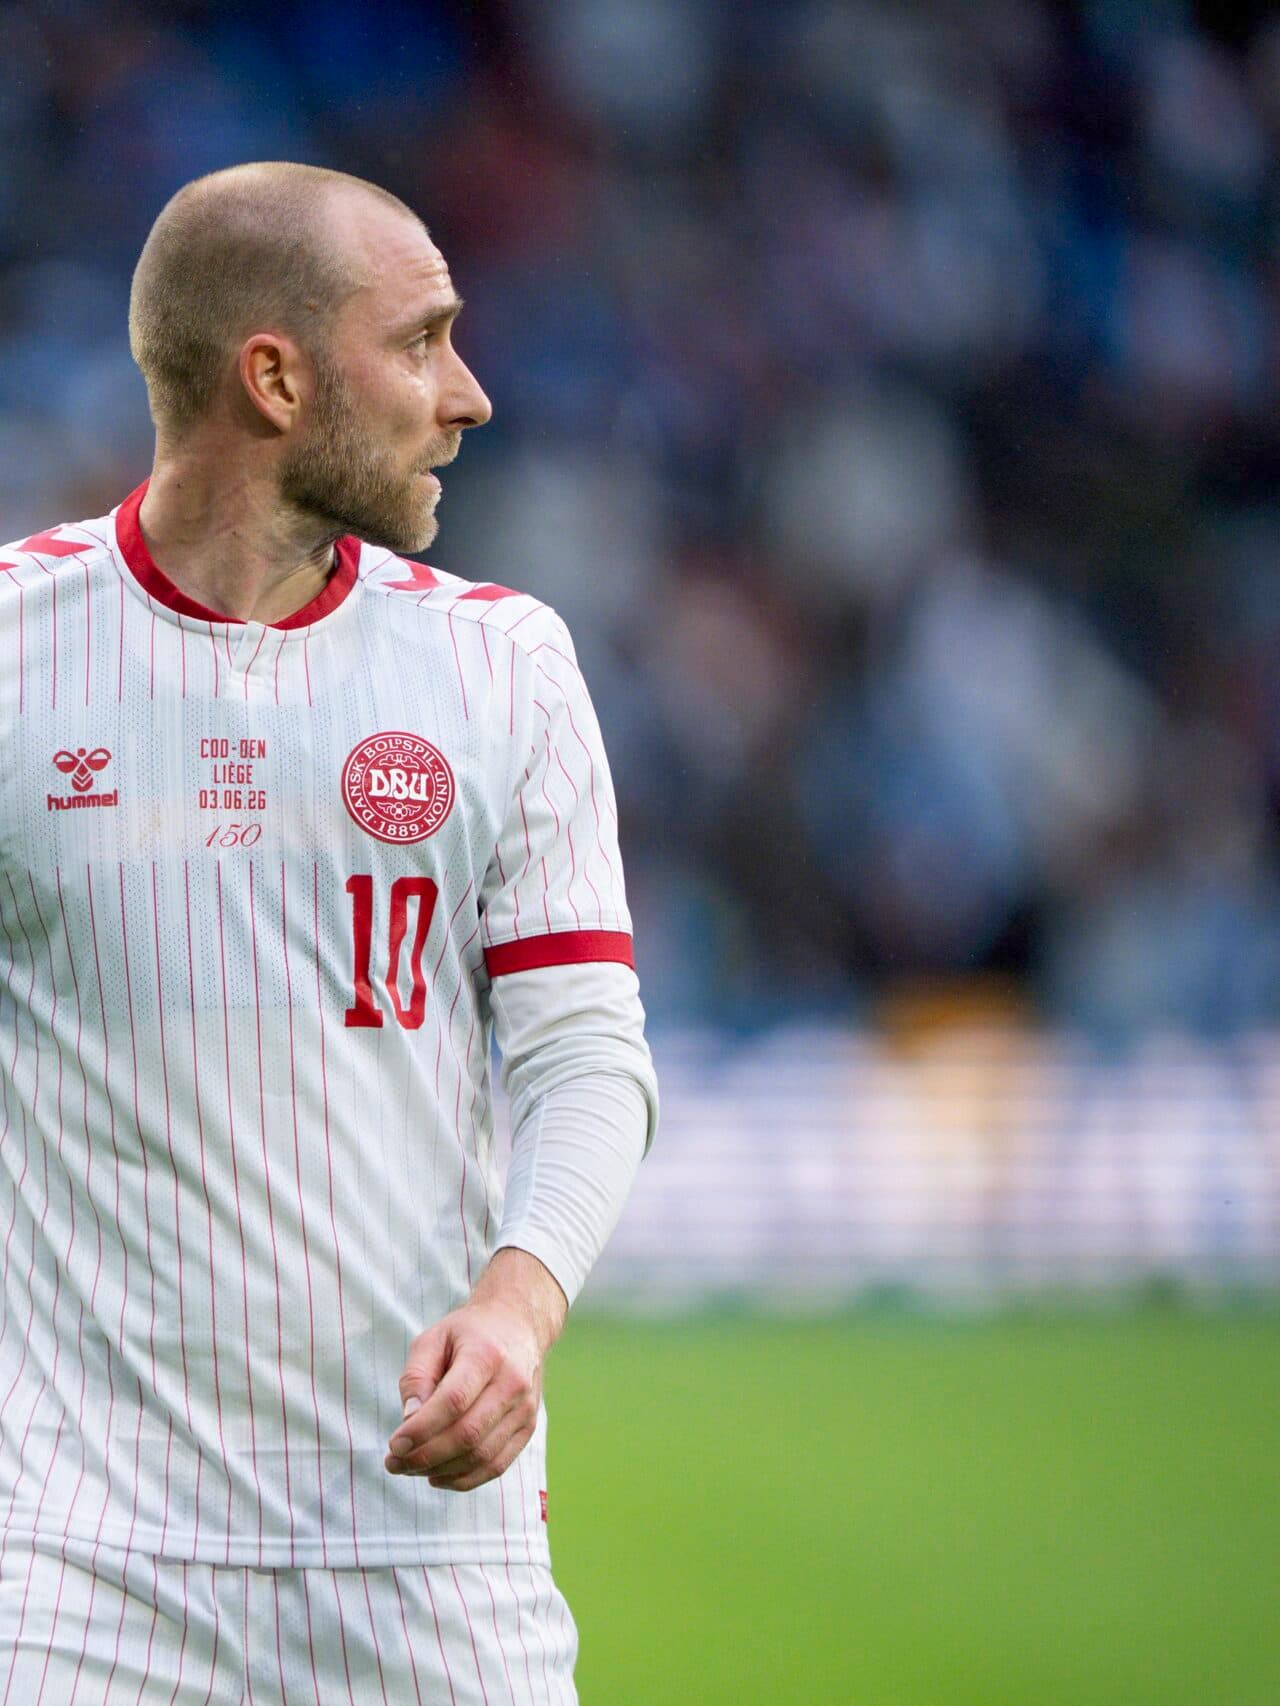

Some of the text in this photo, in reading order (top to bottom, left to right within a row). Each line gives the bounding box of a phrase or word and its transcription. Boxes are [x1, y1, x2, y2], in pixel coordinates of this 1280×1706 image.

[213, 761, 253, 784] LIÈGE
[368, 768, 430, 802] DBU
[47, 789, 119, 812] hummel
[199, 790, 266, 810] 03.06.26
[205, 823, 262, 847] 150
[378, 821, 419, 837] 1889
[344, 874, 439, 1031] 10
